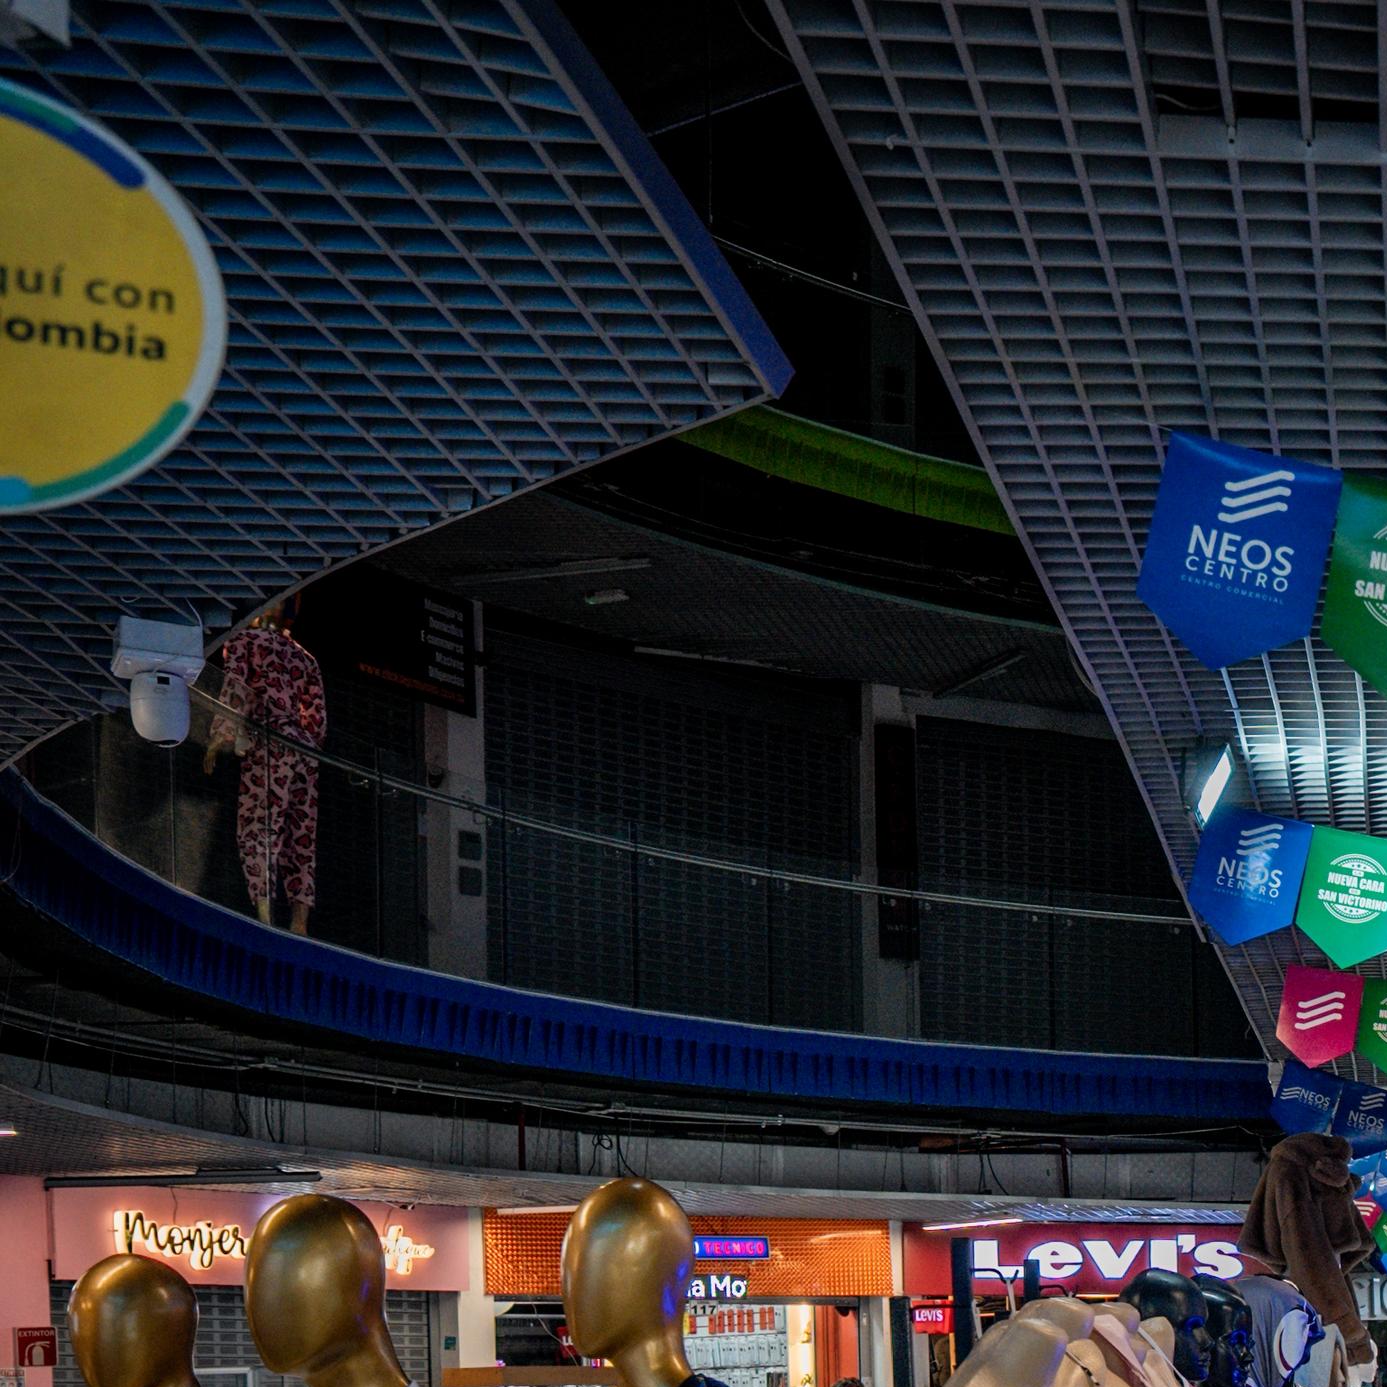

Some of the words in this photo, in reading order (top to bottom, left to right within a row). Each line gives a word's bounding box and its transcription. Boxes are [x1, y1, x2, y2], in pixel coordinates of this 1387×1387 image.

[85, 278, 175, 314] con
[3, 315, 167, 361] ombia
[1187, 525, 1295, 577] NEOS
[1181, 574, 1221, 590] CENTRO
[1185, 555, 1288, 592] CENTRO
[1354, 579, 1385, 600] SAN
[1217, 857, 1283, 888] NEOS
[1328, 872, 1358, 888] NUEVA
[1359, 878, 1385, 893] CARA
[1216, 876, 1279, 898] CENTRO
[1318, 889, 1337, 903] SAN
[1300, 1088, 1331, 1107] NEOS
[1348, 1110, 1385, 1128] NEOS
[703, 1241, 765, 1255] TECNICO
[710, 1275, 747, 1297] Mo
[691, 1305, 716, 1314] 117
[18, 1330, 55, 1338] EXTINTOR
